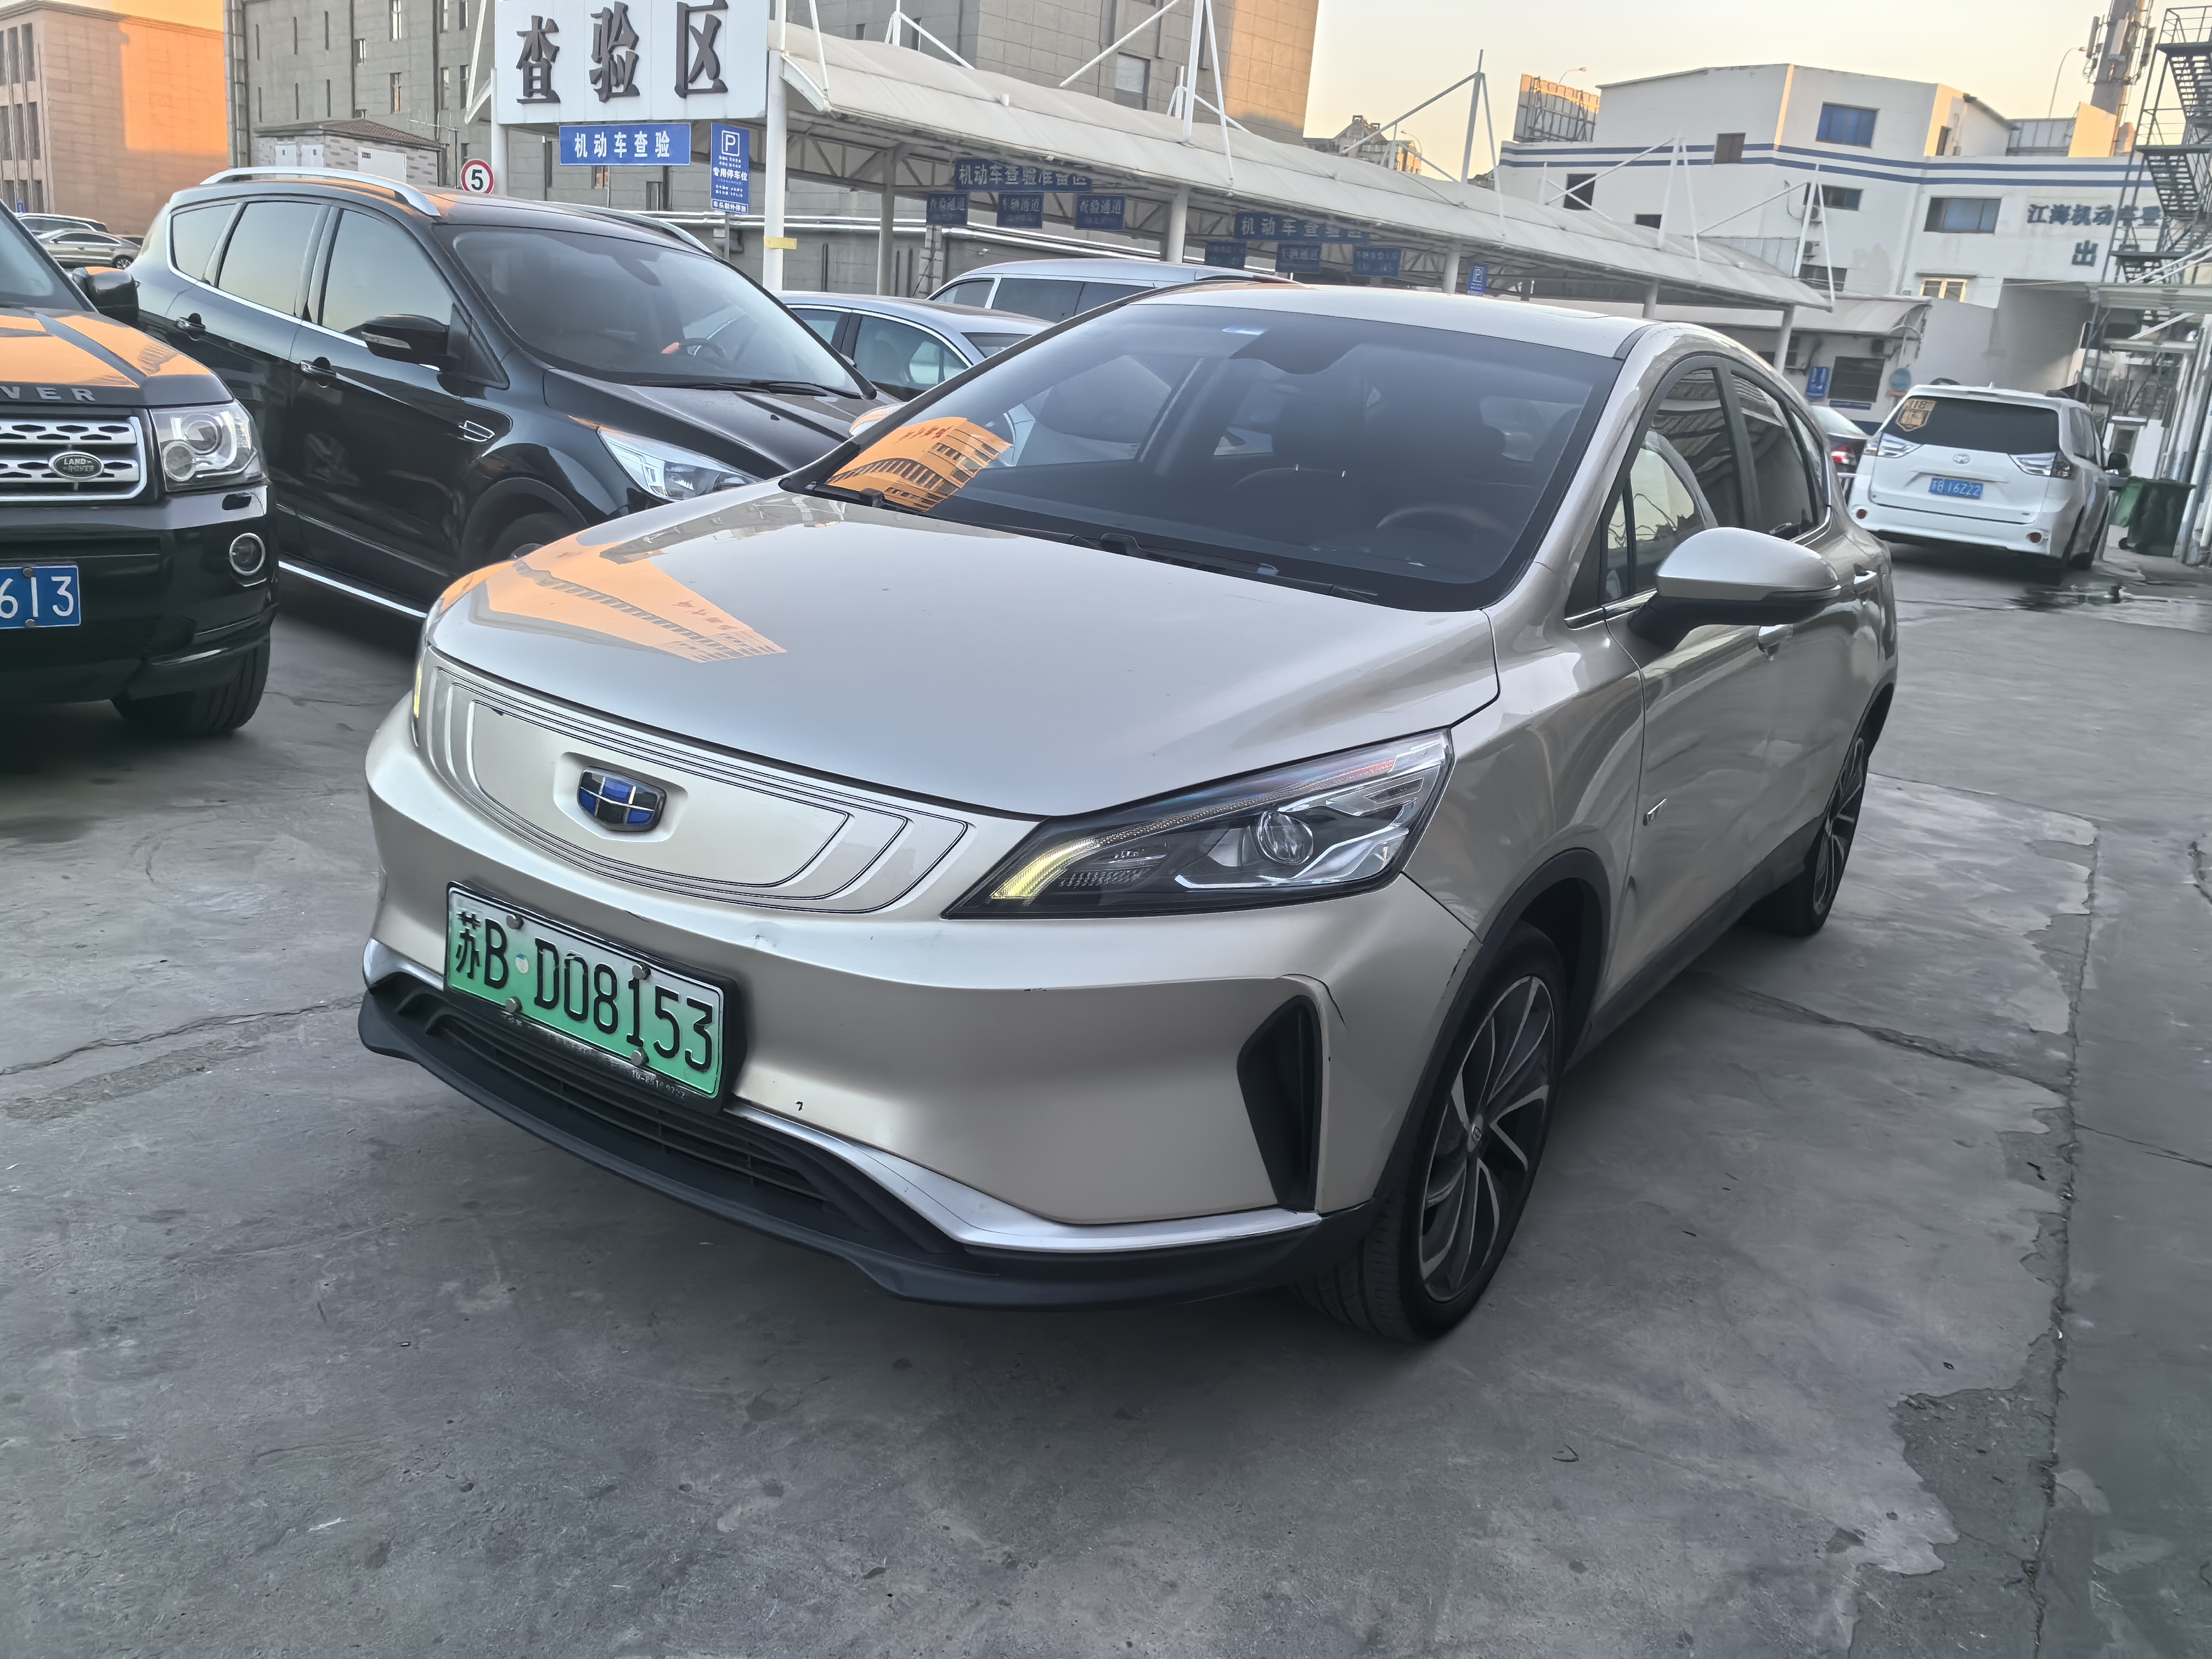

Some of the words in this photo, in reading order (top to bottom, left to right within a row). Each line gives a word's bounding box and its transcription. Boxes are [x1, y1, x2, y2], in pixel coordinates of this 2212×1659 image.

[516, 0, 729, 104] 查验区
[575, 131, 670, 158] 机动车查验
[725, 134, 736, 152] P
[470, 169, 484, 191] 5
[713, 167, 748, 181] 专用停车位
[2071, 240, 2099, 267] 出
[0, 386, 96, 401] VER
[0, 576, 74, 619] 613
